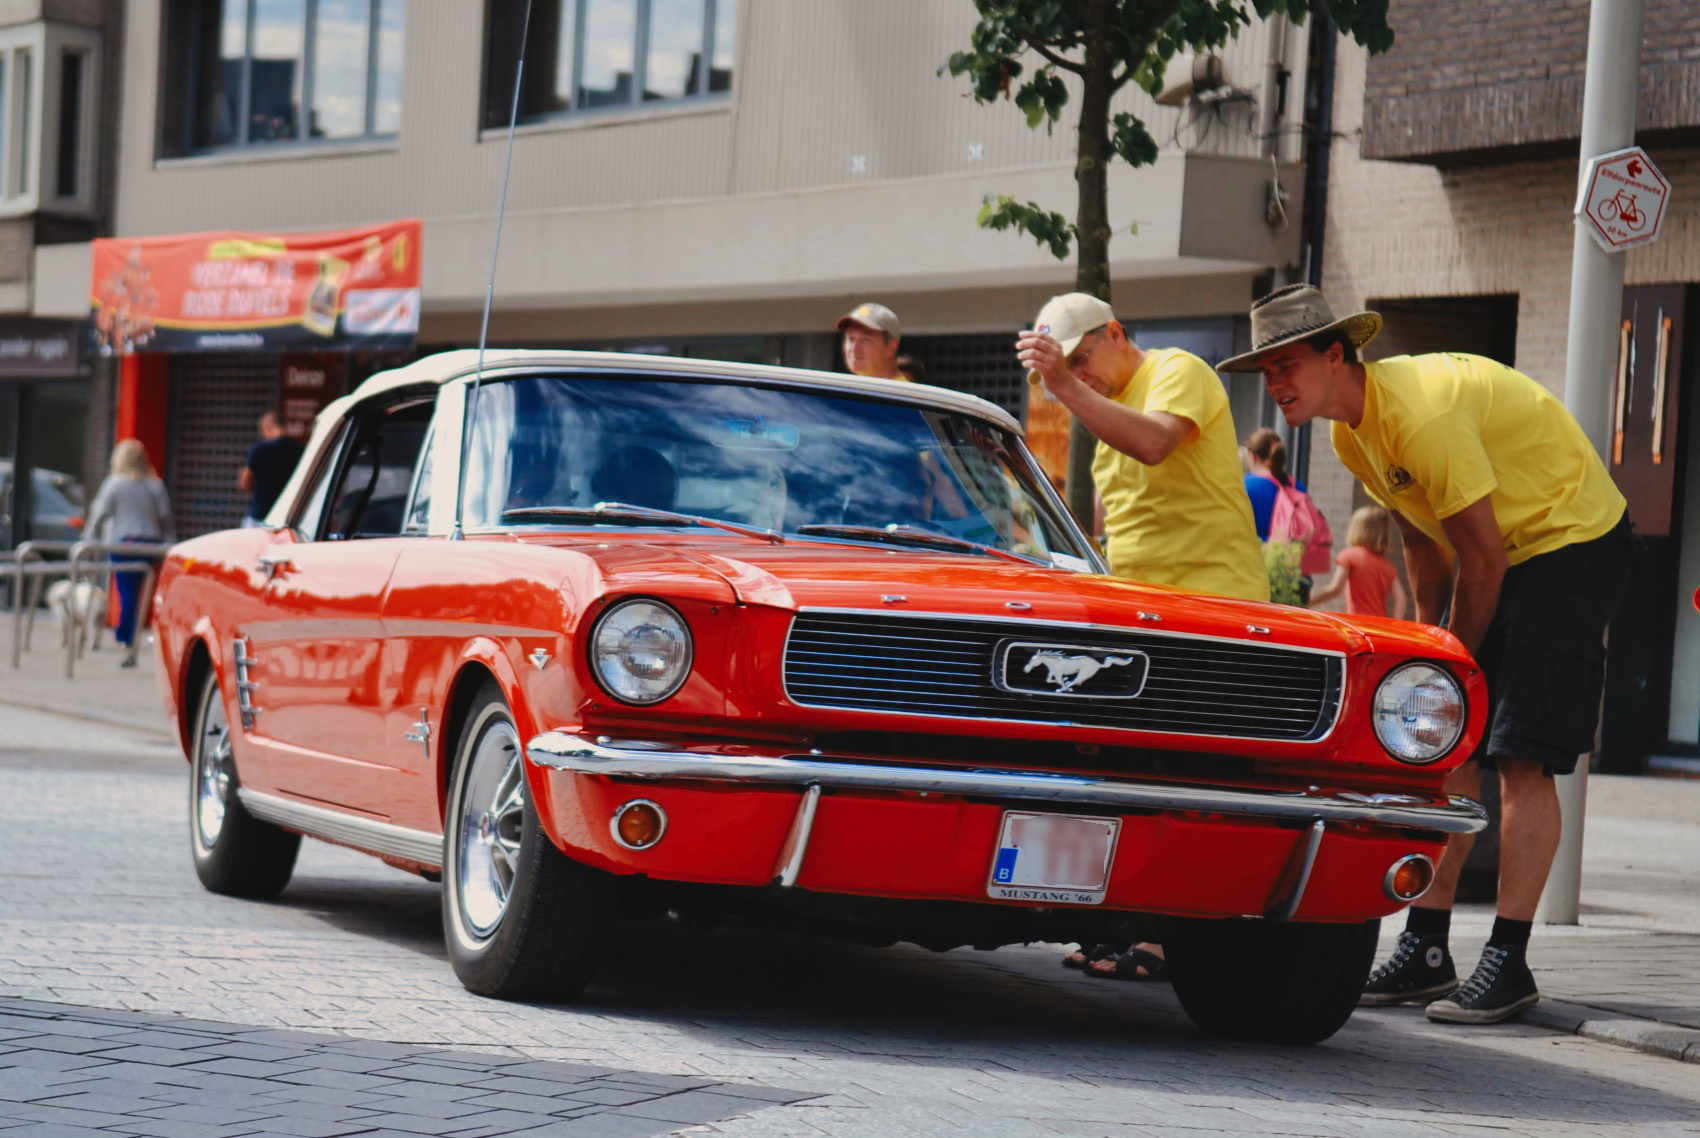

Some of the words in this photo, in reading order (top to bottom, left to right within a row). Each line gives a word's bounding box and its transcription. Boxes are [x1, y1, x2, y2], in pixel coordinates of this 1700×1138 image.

[999, 868, 1009, 879] B
[1001, 889, 1070, 902] MUSTANG
[1075, 893, 1093, 903] '66
